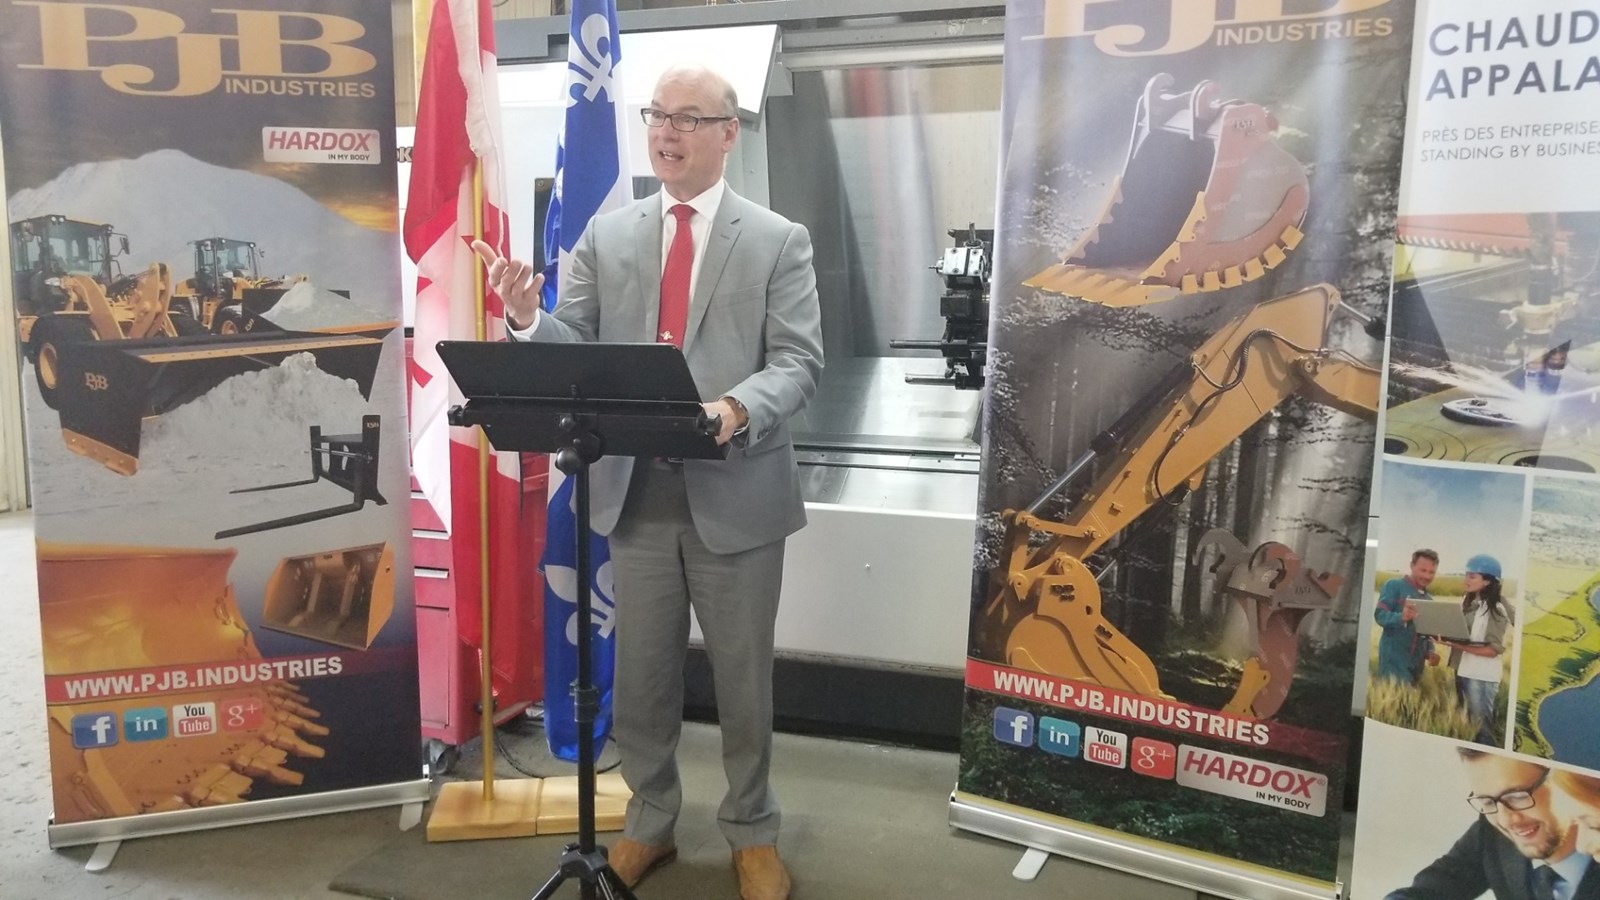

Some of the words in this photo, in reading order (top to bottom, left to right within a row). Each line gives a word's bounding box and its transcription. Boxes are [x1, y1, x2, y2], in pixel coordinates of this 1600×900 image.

[1216, 17, 1393, 47] INDUSTRIES
[1429, 10, 1600, 56] CHAUD
[11, 1, 378, 97] PJB
[225, 77, 376, 98] INDUSTRIES
[1425, 56, 1600, 102] APPALA
[268, 130, 371, 152] HARDOX
[1422, 126, 1458, 143] PRÈS
[1464, 126, 1495, 141] DES
[1420, 145, 1504, 162] STANDING
[1509, 144, 1531, 158] BY
[65, 656, 343, 700] WWW.PJB.INDUSTRIES
[184, 704, 206, 717] You
[993, 669, 1271, 746] WWW.PJB.INDUSTRIES
[135, 716, 158, 733] in
[180, 718, 210, 733] Tube
[1049, 726, 1070, 746] in
[1096, 729, 1117, 746] You
[1091, 744, 1120, 764] Tube
[1255, 791, 1266, 800] IN
[1267, 793, 1283, 803] MY
[1284, 797, 1311, 810] BODY
